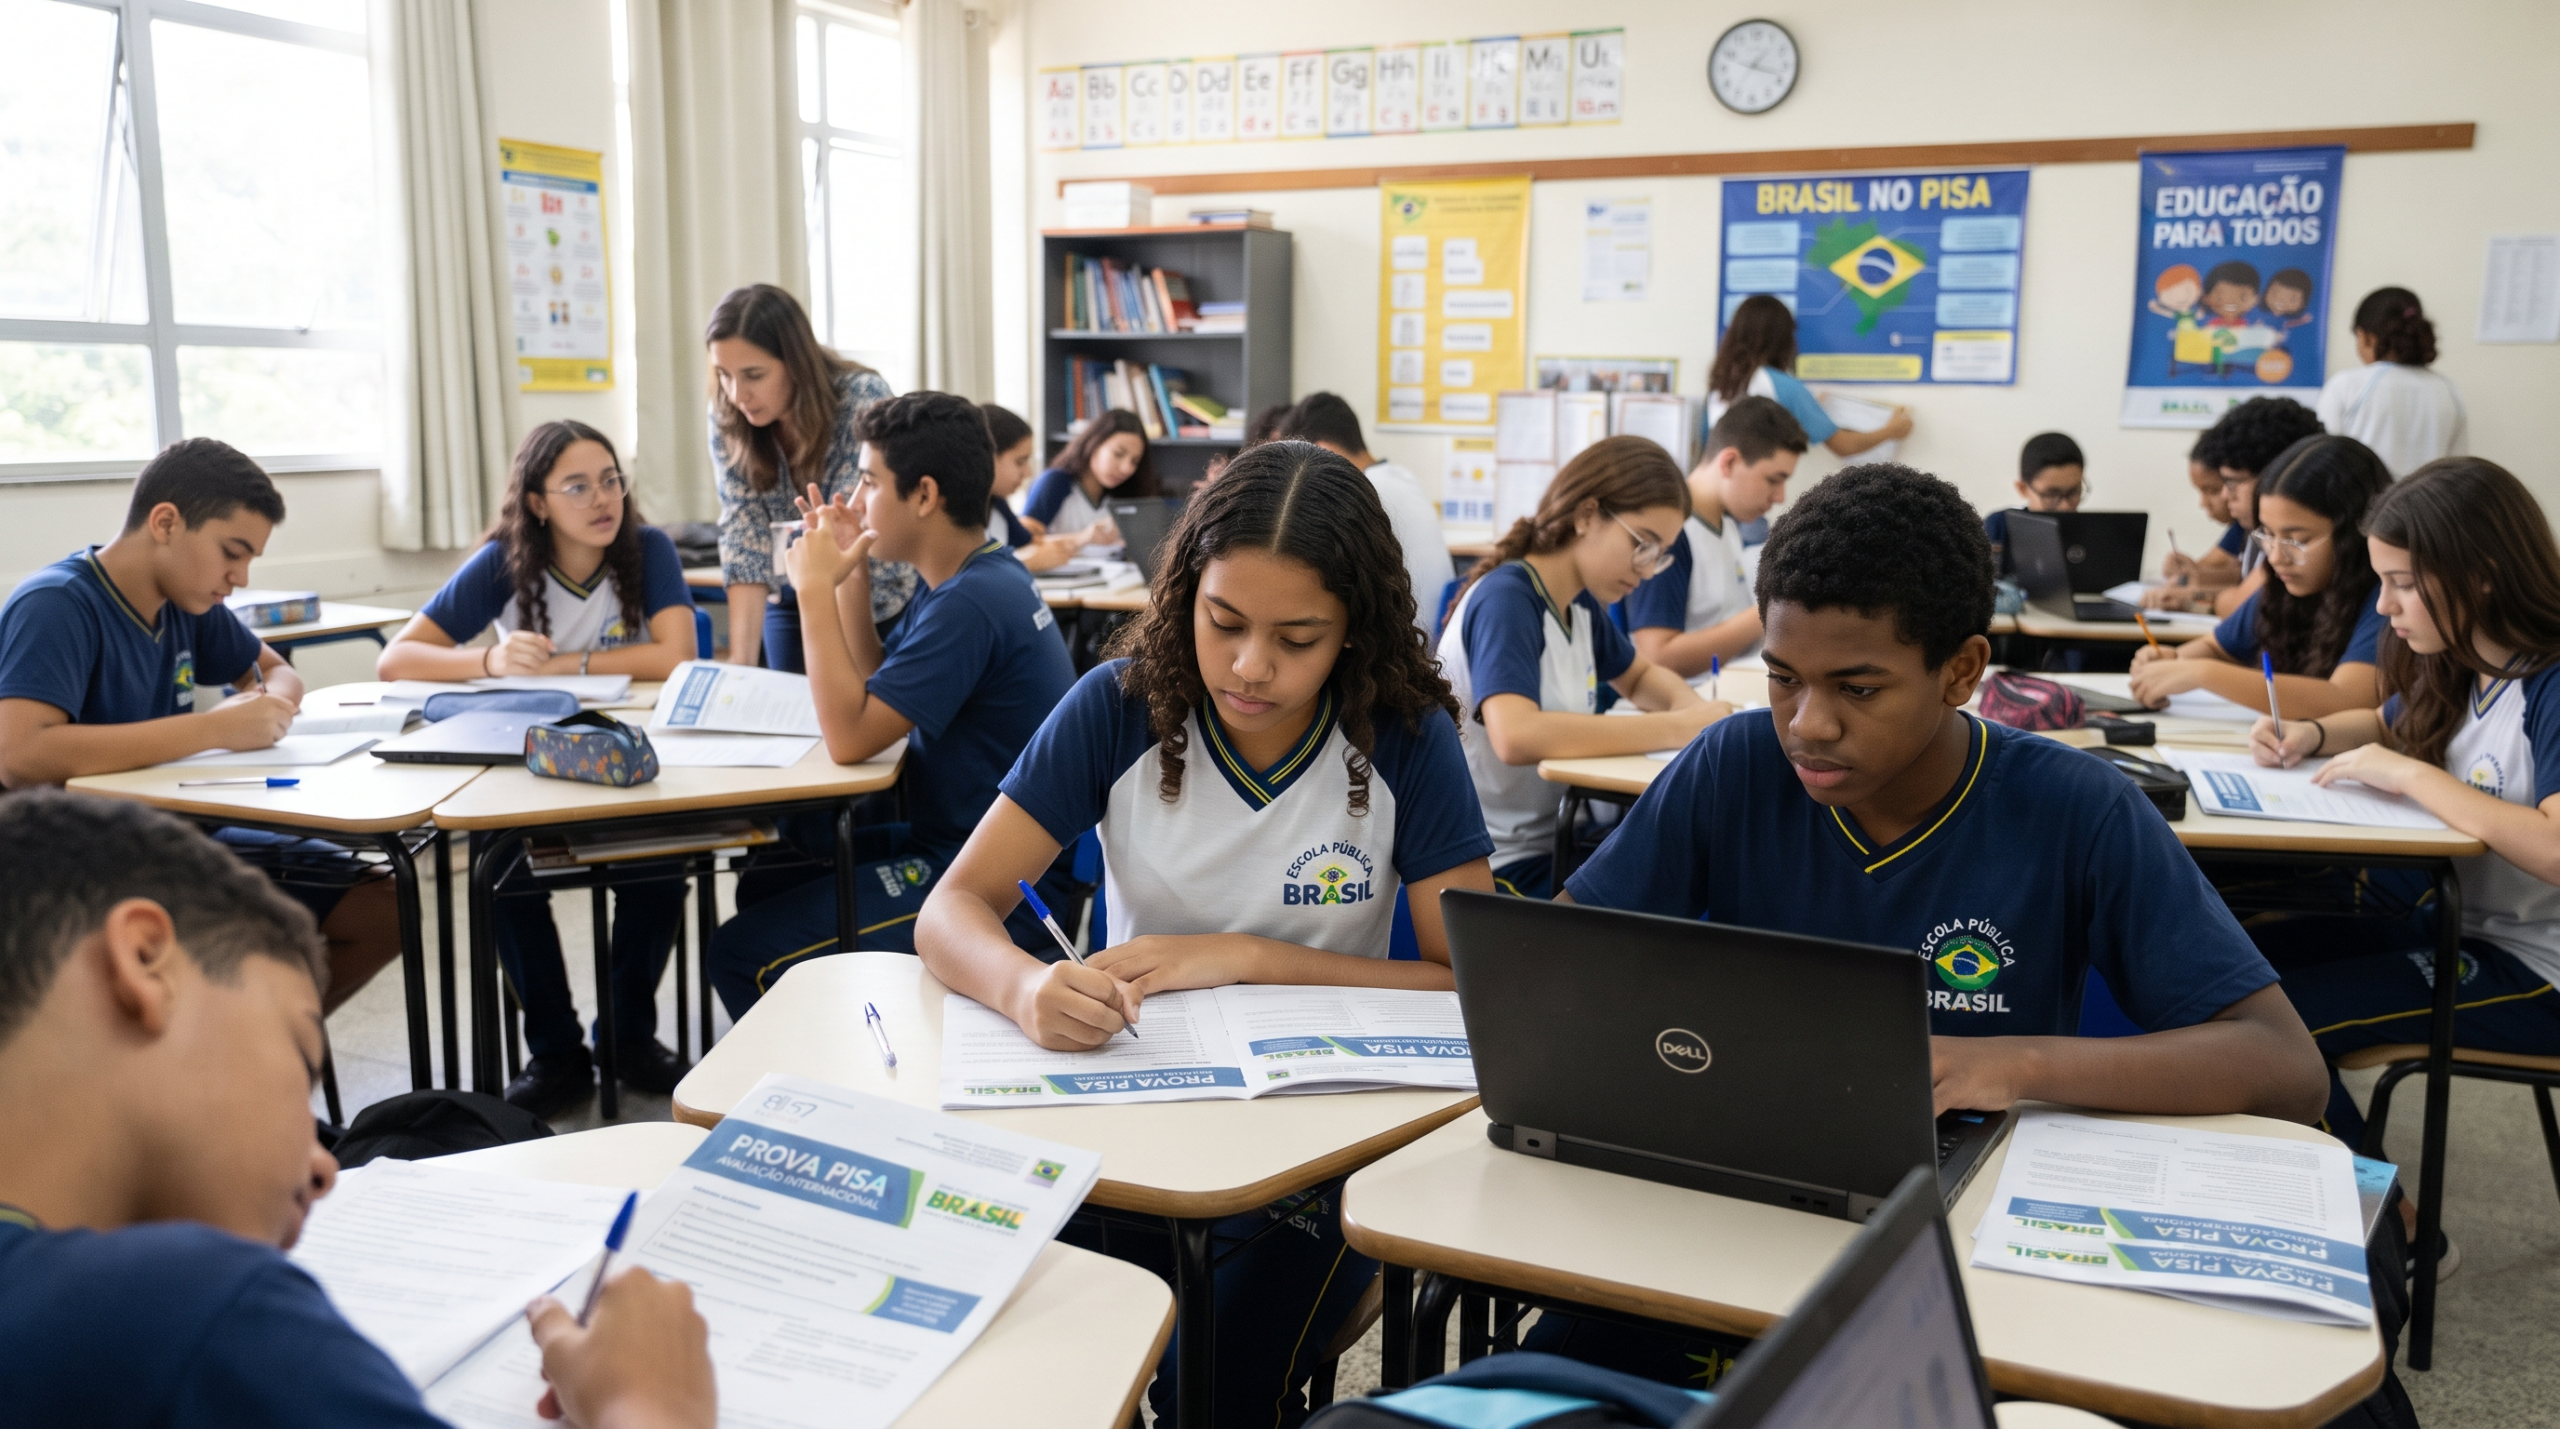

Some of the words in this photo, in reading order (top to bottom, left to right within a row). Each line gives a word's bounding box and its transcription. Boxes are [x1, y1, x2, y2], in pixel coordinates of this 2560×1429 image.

[1130, 67, 1159, 97] Cc
[1198, 67, 1232, 93] Dd
[1244, 66, 1271, 91] Ee
[1331, 58, 1368, 89] Gg
[1379, 54, 1414, 81] Hh
[1756, 181, 1862, 215] BRASIL
[1868, 179, 1913, 211] NO
[1919, 176, 1992, 210] PISA
[2155, 174, 2324, 220] EDUCAÇÃO
[2153, 220, 2225, 249] PARA
[2230, 216, 2322, 248] TODOS
[1286, 844, 1329, 879] ESCOLA
[1332, 839, 1374, 878] PÚBLICA
[1283, 880, 1374, 905] BRASIL
[1918, 918, 1964, 961] ESCOLA
[1968, 918, 2016, 968] PÚBLICA
[1363, 1043, 1418, 1055] PISA
[1422, 1045, 1471, 1056] OVA
[1663, 1042, 1706, 1060] DELL
[1074, 1079, 1129, 1091] PISA
[1135, 1074, 1216, 1088] PROVA
[728, 1133, 822, 1178] PROVA
[823, 1161, 889, 1198] PISA
[715, 1154, 784, 1184] AVALIAÇÃO
[783, 1174, 880, 1212] INTERNACIONAL
[925, 1189, 1026, 1231] BRASIL
[2153, 1225, 2221, 1242] PISA
[2230, 1233, 2328, 1259] PROVA
[2152, 1257, 2221, 1273] PISA
[2230, 1263, 2334, 1293] PROVA
